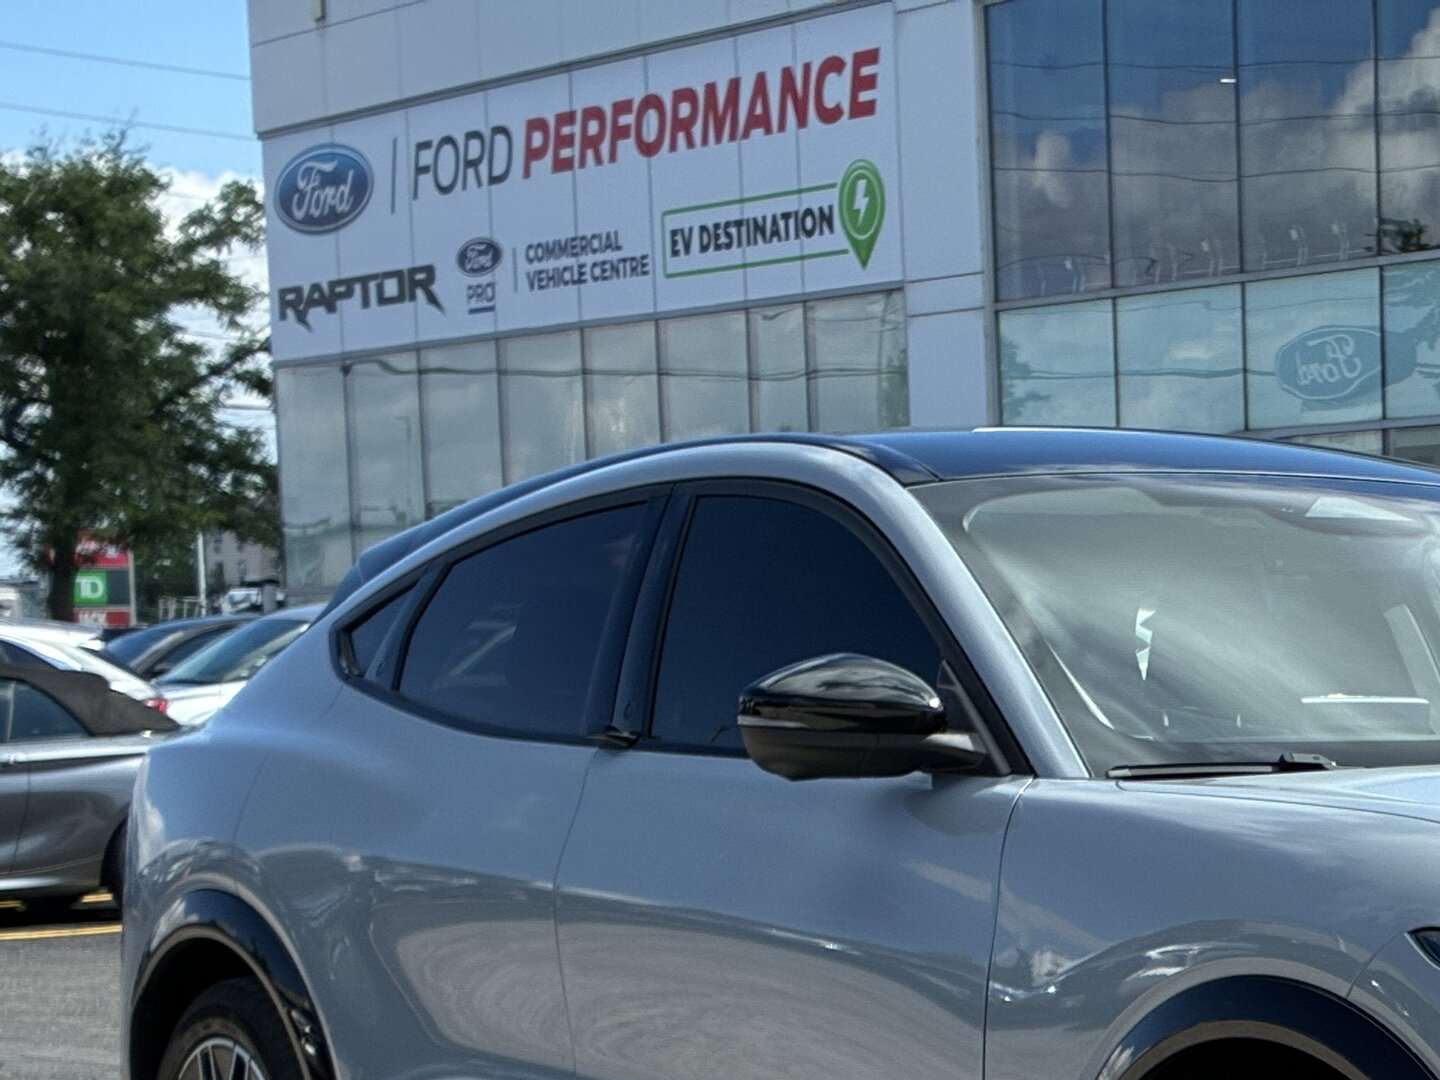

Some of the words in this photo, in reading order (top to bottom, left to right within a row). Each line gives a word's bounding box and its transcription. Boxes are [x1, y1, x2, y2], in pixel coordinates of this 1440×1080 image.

[412, 125, 513, 201] FORD
[522, 47, 881, 179] PERFORMANCE
[291, 159, 355, 221] Ford
[525, 230, 623, 264] COMMERCIAL
[669, 226, 697, 259] EV
[699, 205, 834, 254] DESTINATION
[467, 282, 496, 304] PRO
[525, 263, 588, 292] VEHICLE
[590, 253, 650, 285] CENTRE
[277, 264, 447, 333] RAPTOR
[75, 575, 105, 599] TD
